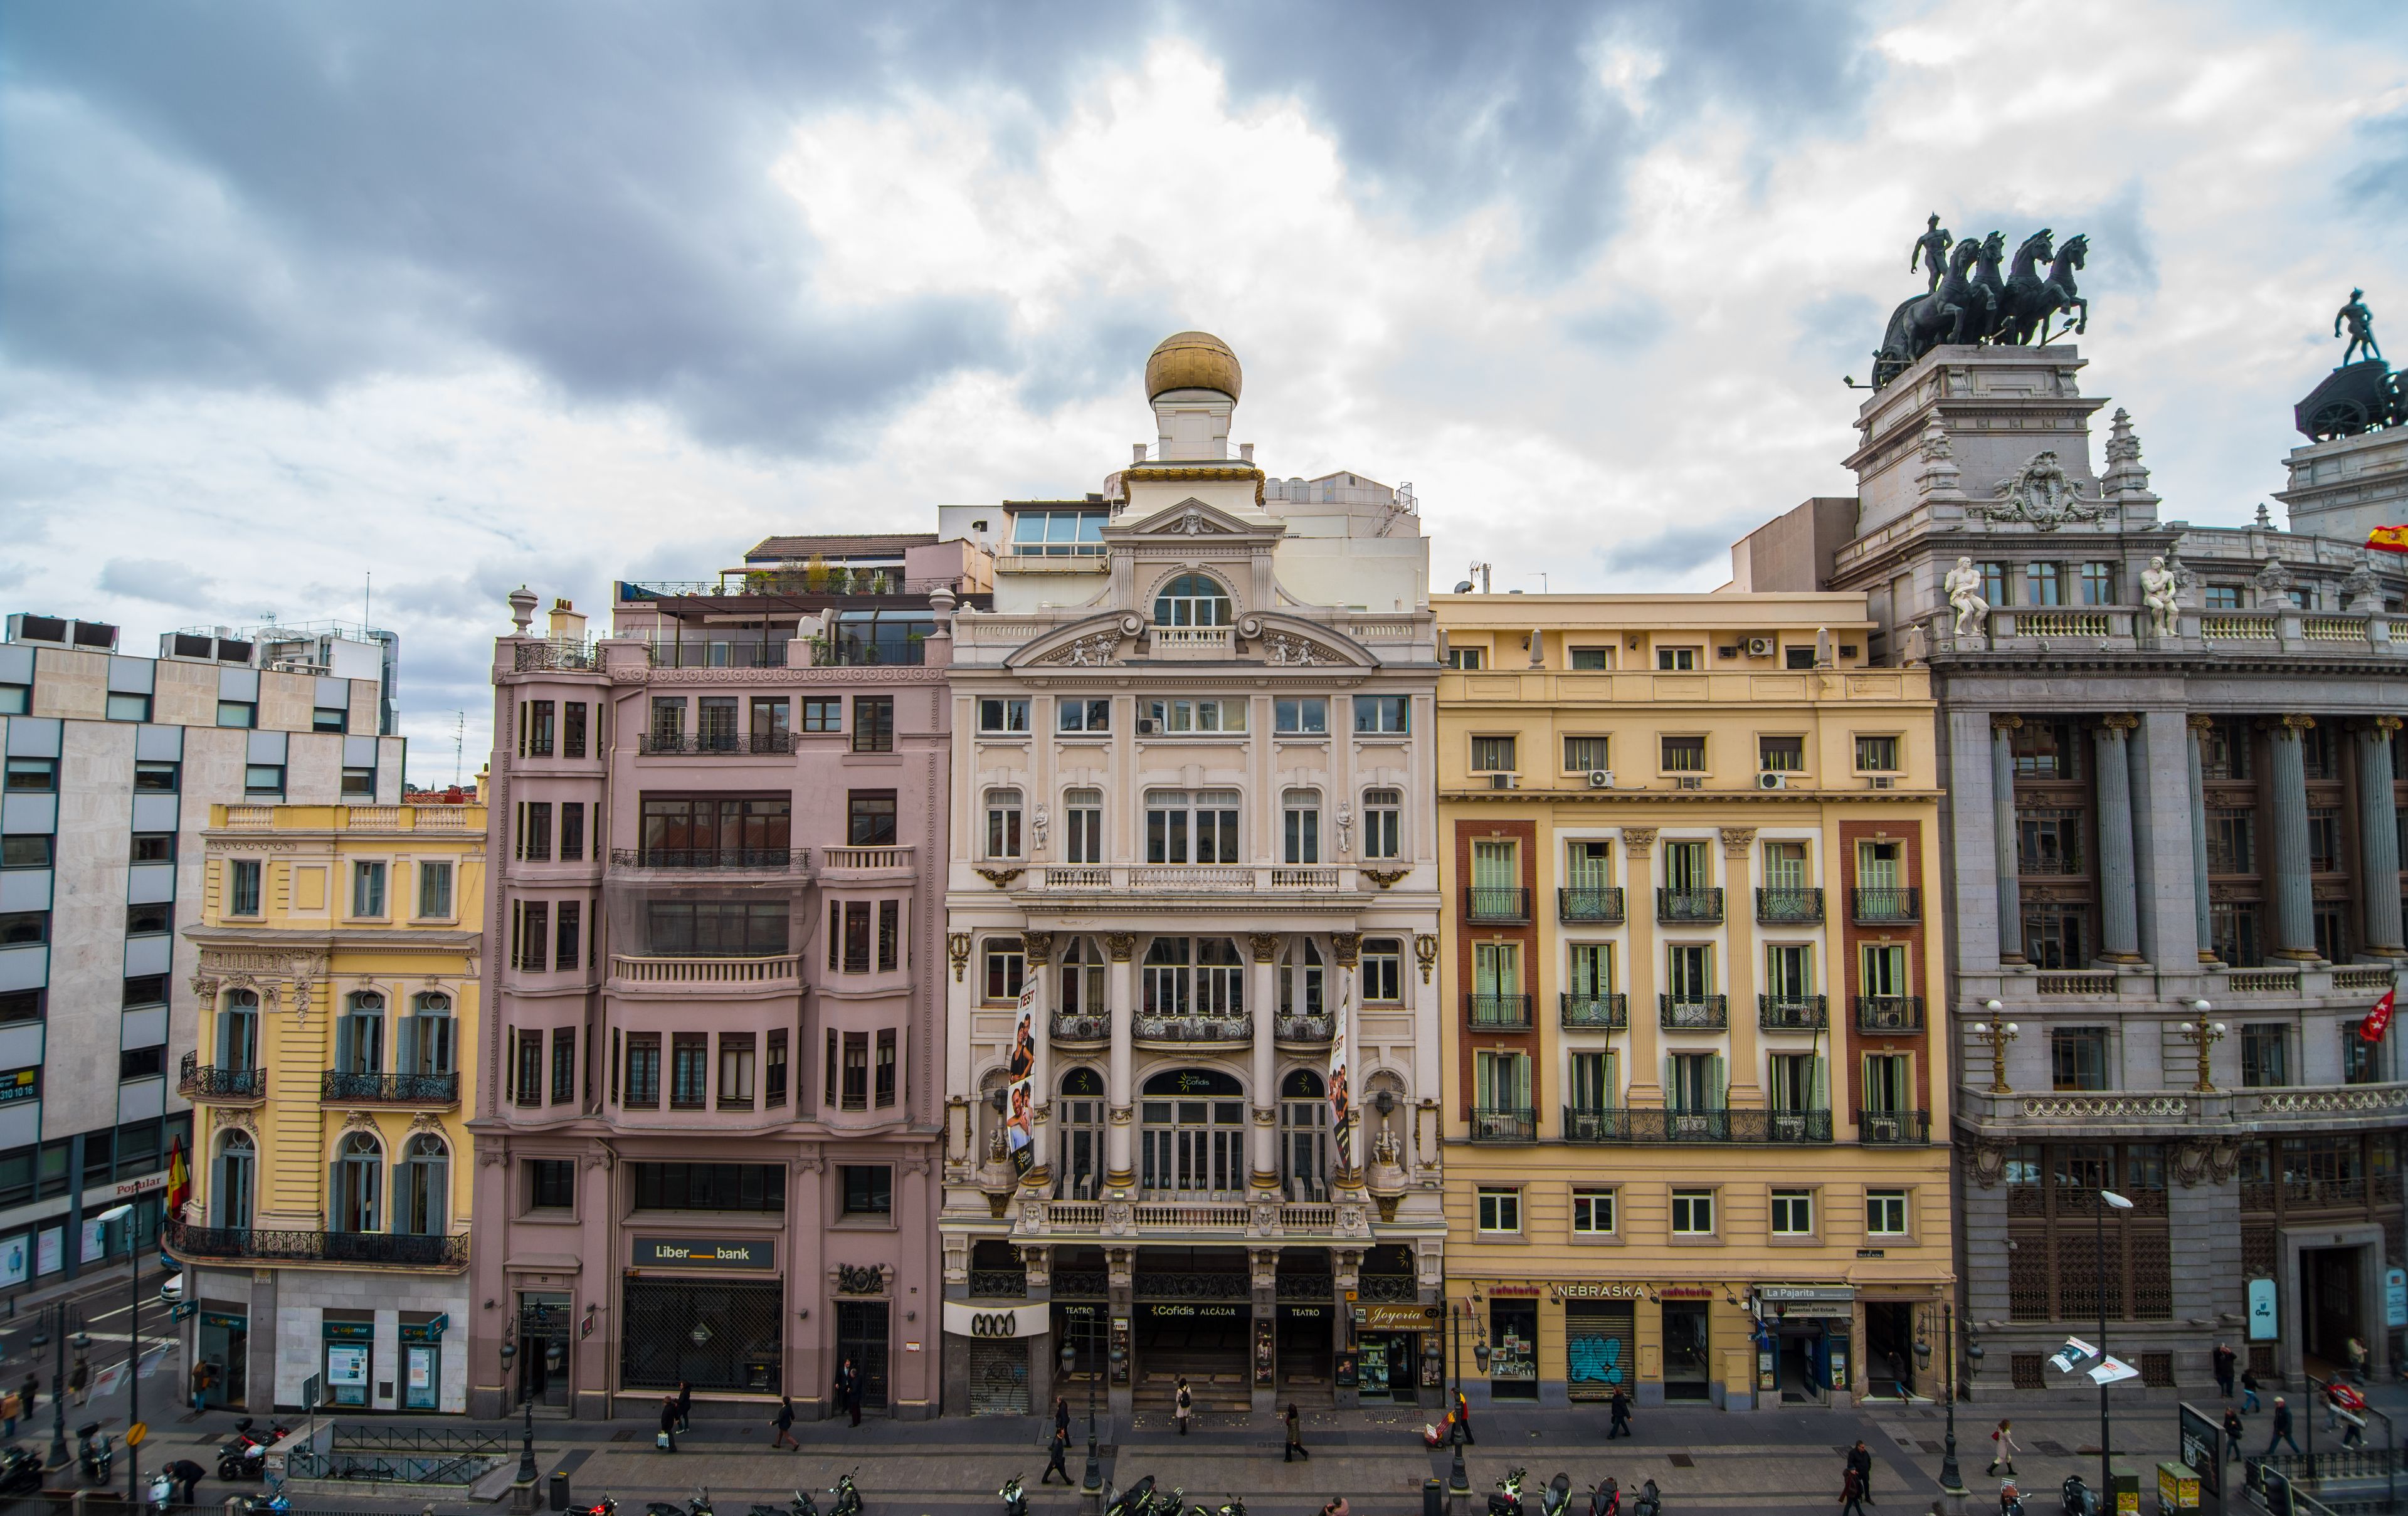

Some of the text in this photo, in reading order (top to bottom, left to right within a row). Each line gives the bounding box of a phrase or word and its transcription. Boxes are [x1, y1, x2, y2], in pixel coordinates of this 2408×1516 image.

[1020, 989, 1035, 1009] TEST
[1333, 1034, 1344, 1055] TEST
[15, 1087, 23, 1097] 10
[24, 1085, 33, 1095] 16
[117, 1177, 161, 1195] Popular
[2334, 1234, 2343, 1243] 16
[656, 1246, 750, 1260] Liber bank
[1558, 1286, 1645, 1297] NEBRASKA
[1767, 1288, 1778, 1297] La
[1781, 1288, 1814, 1298] Pajarita
[176, 1305, 192, 1315] 24h
[1158, 1306, 1236, 1315] Cofidis ALCÁZAR
[217, 1317, 240, 1327] cajamar
[972, 1310, 1016, 1337] COCÓ
[341, 1326, 367, 1335] cajamar
[2337, 1390, 2354, 1403] Metro
